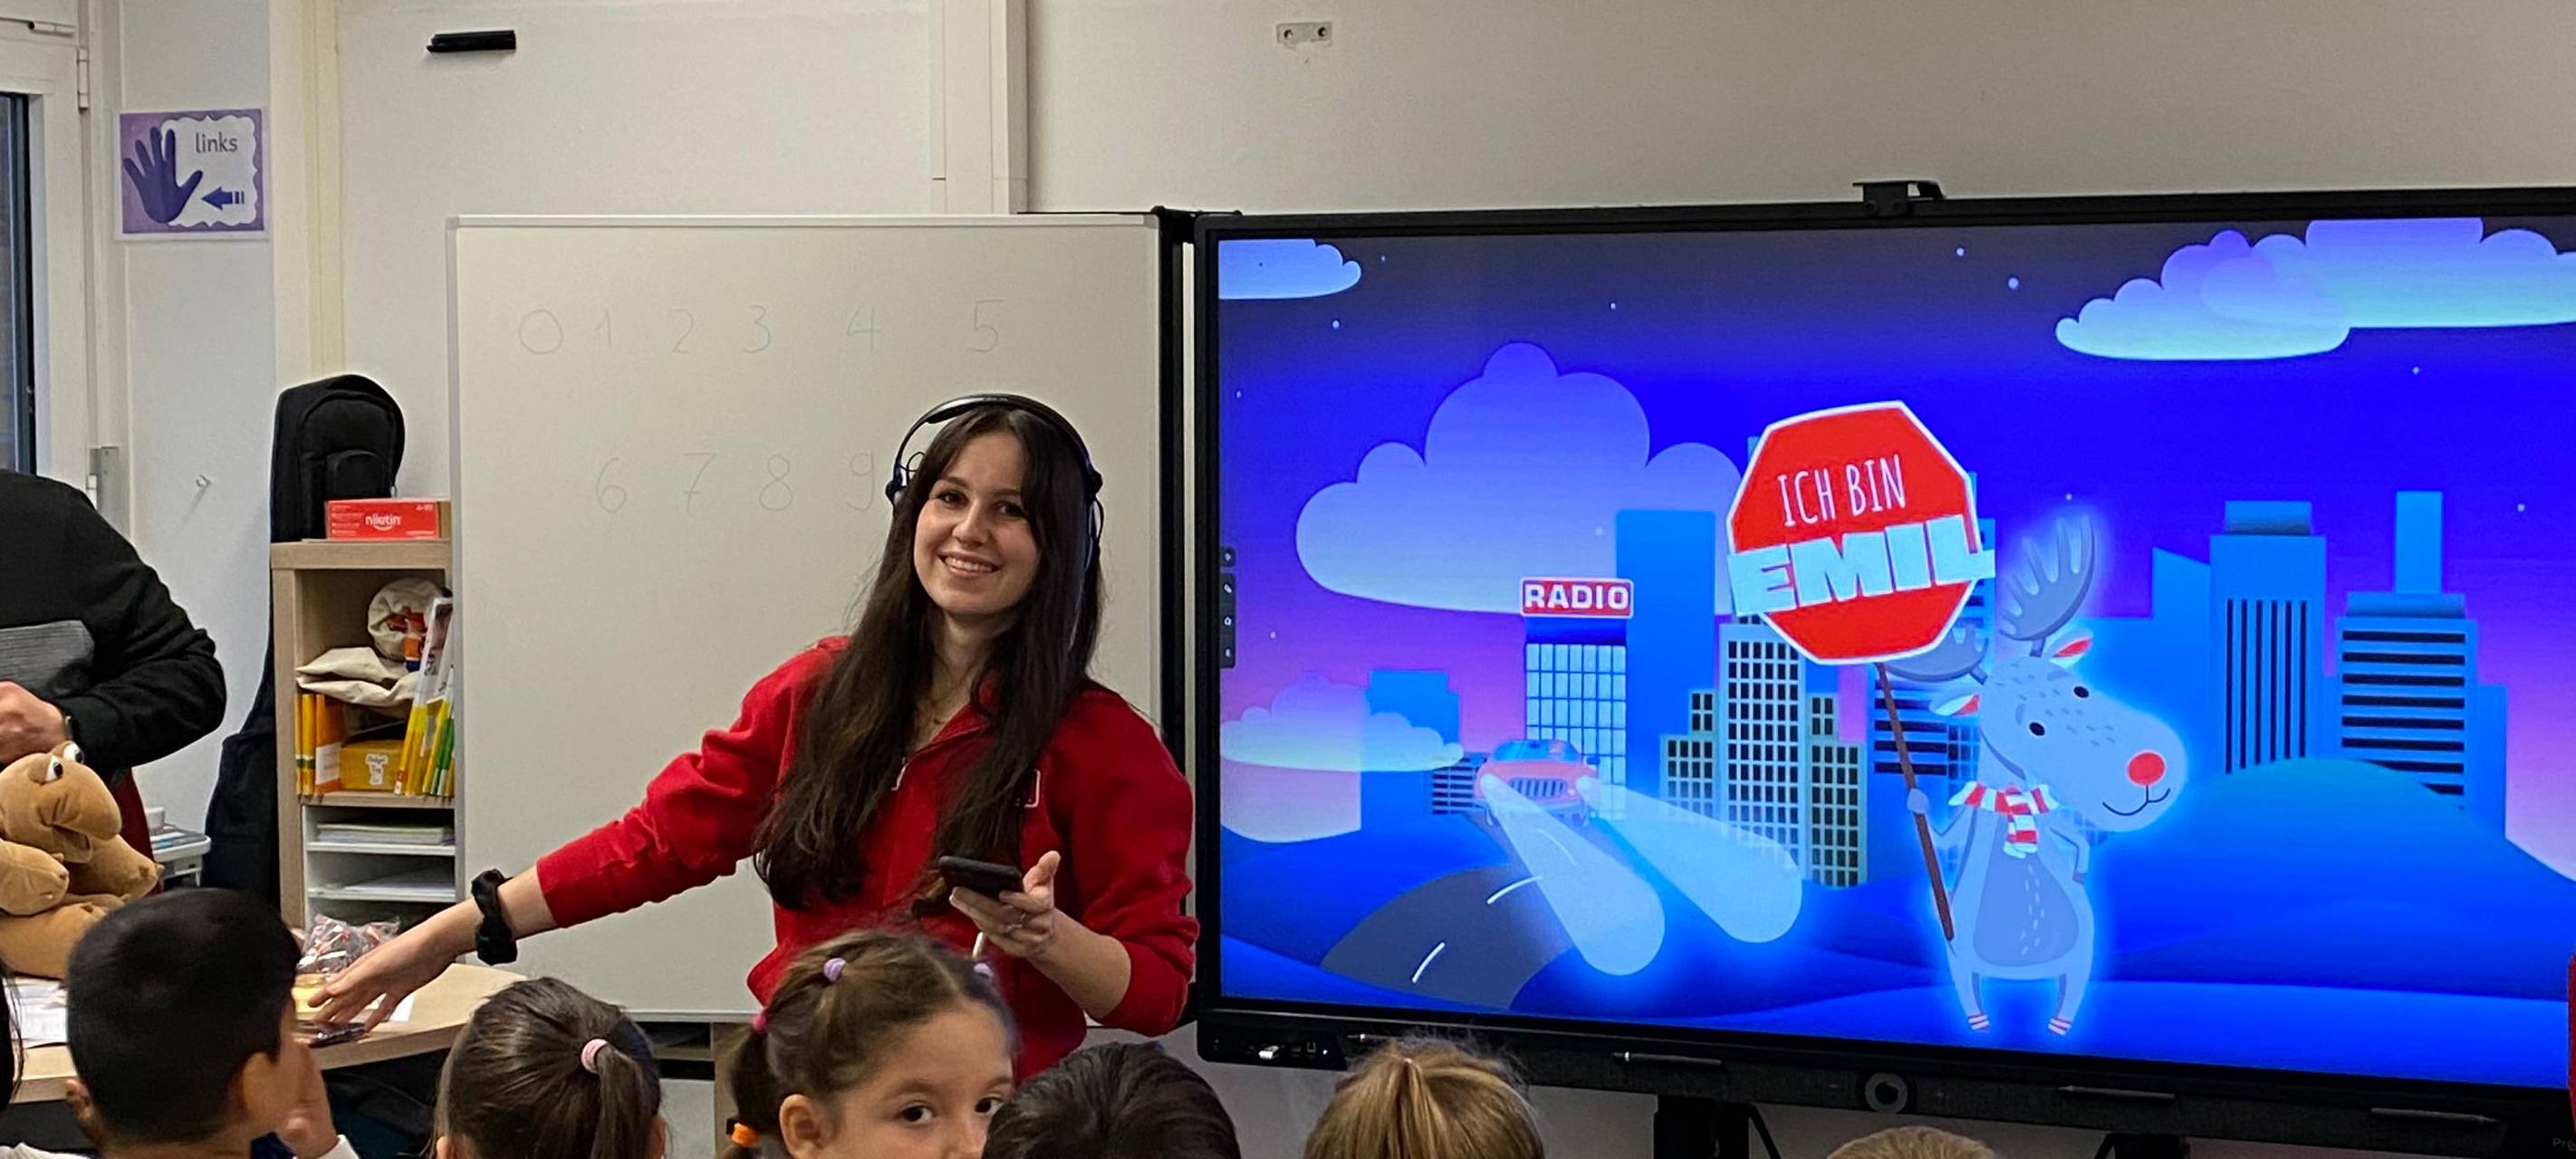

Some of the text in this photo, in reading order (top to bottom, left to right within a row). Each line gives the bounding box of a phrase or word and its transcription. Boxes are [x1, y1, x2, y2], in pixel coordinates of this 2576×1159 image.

[196, 131, 238, 153] links
[518, 300, 1003, 355] 0 1 2 3 4 5
[595, 452, 875, 513] 6 7 8 9
[1777, 455, 1906, 527] ICH BIN
[1726, 514, 1995, 617] EMIL
[1523, 583, 1629, 610] RADIO
